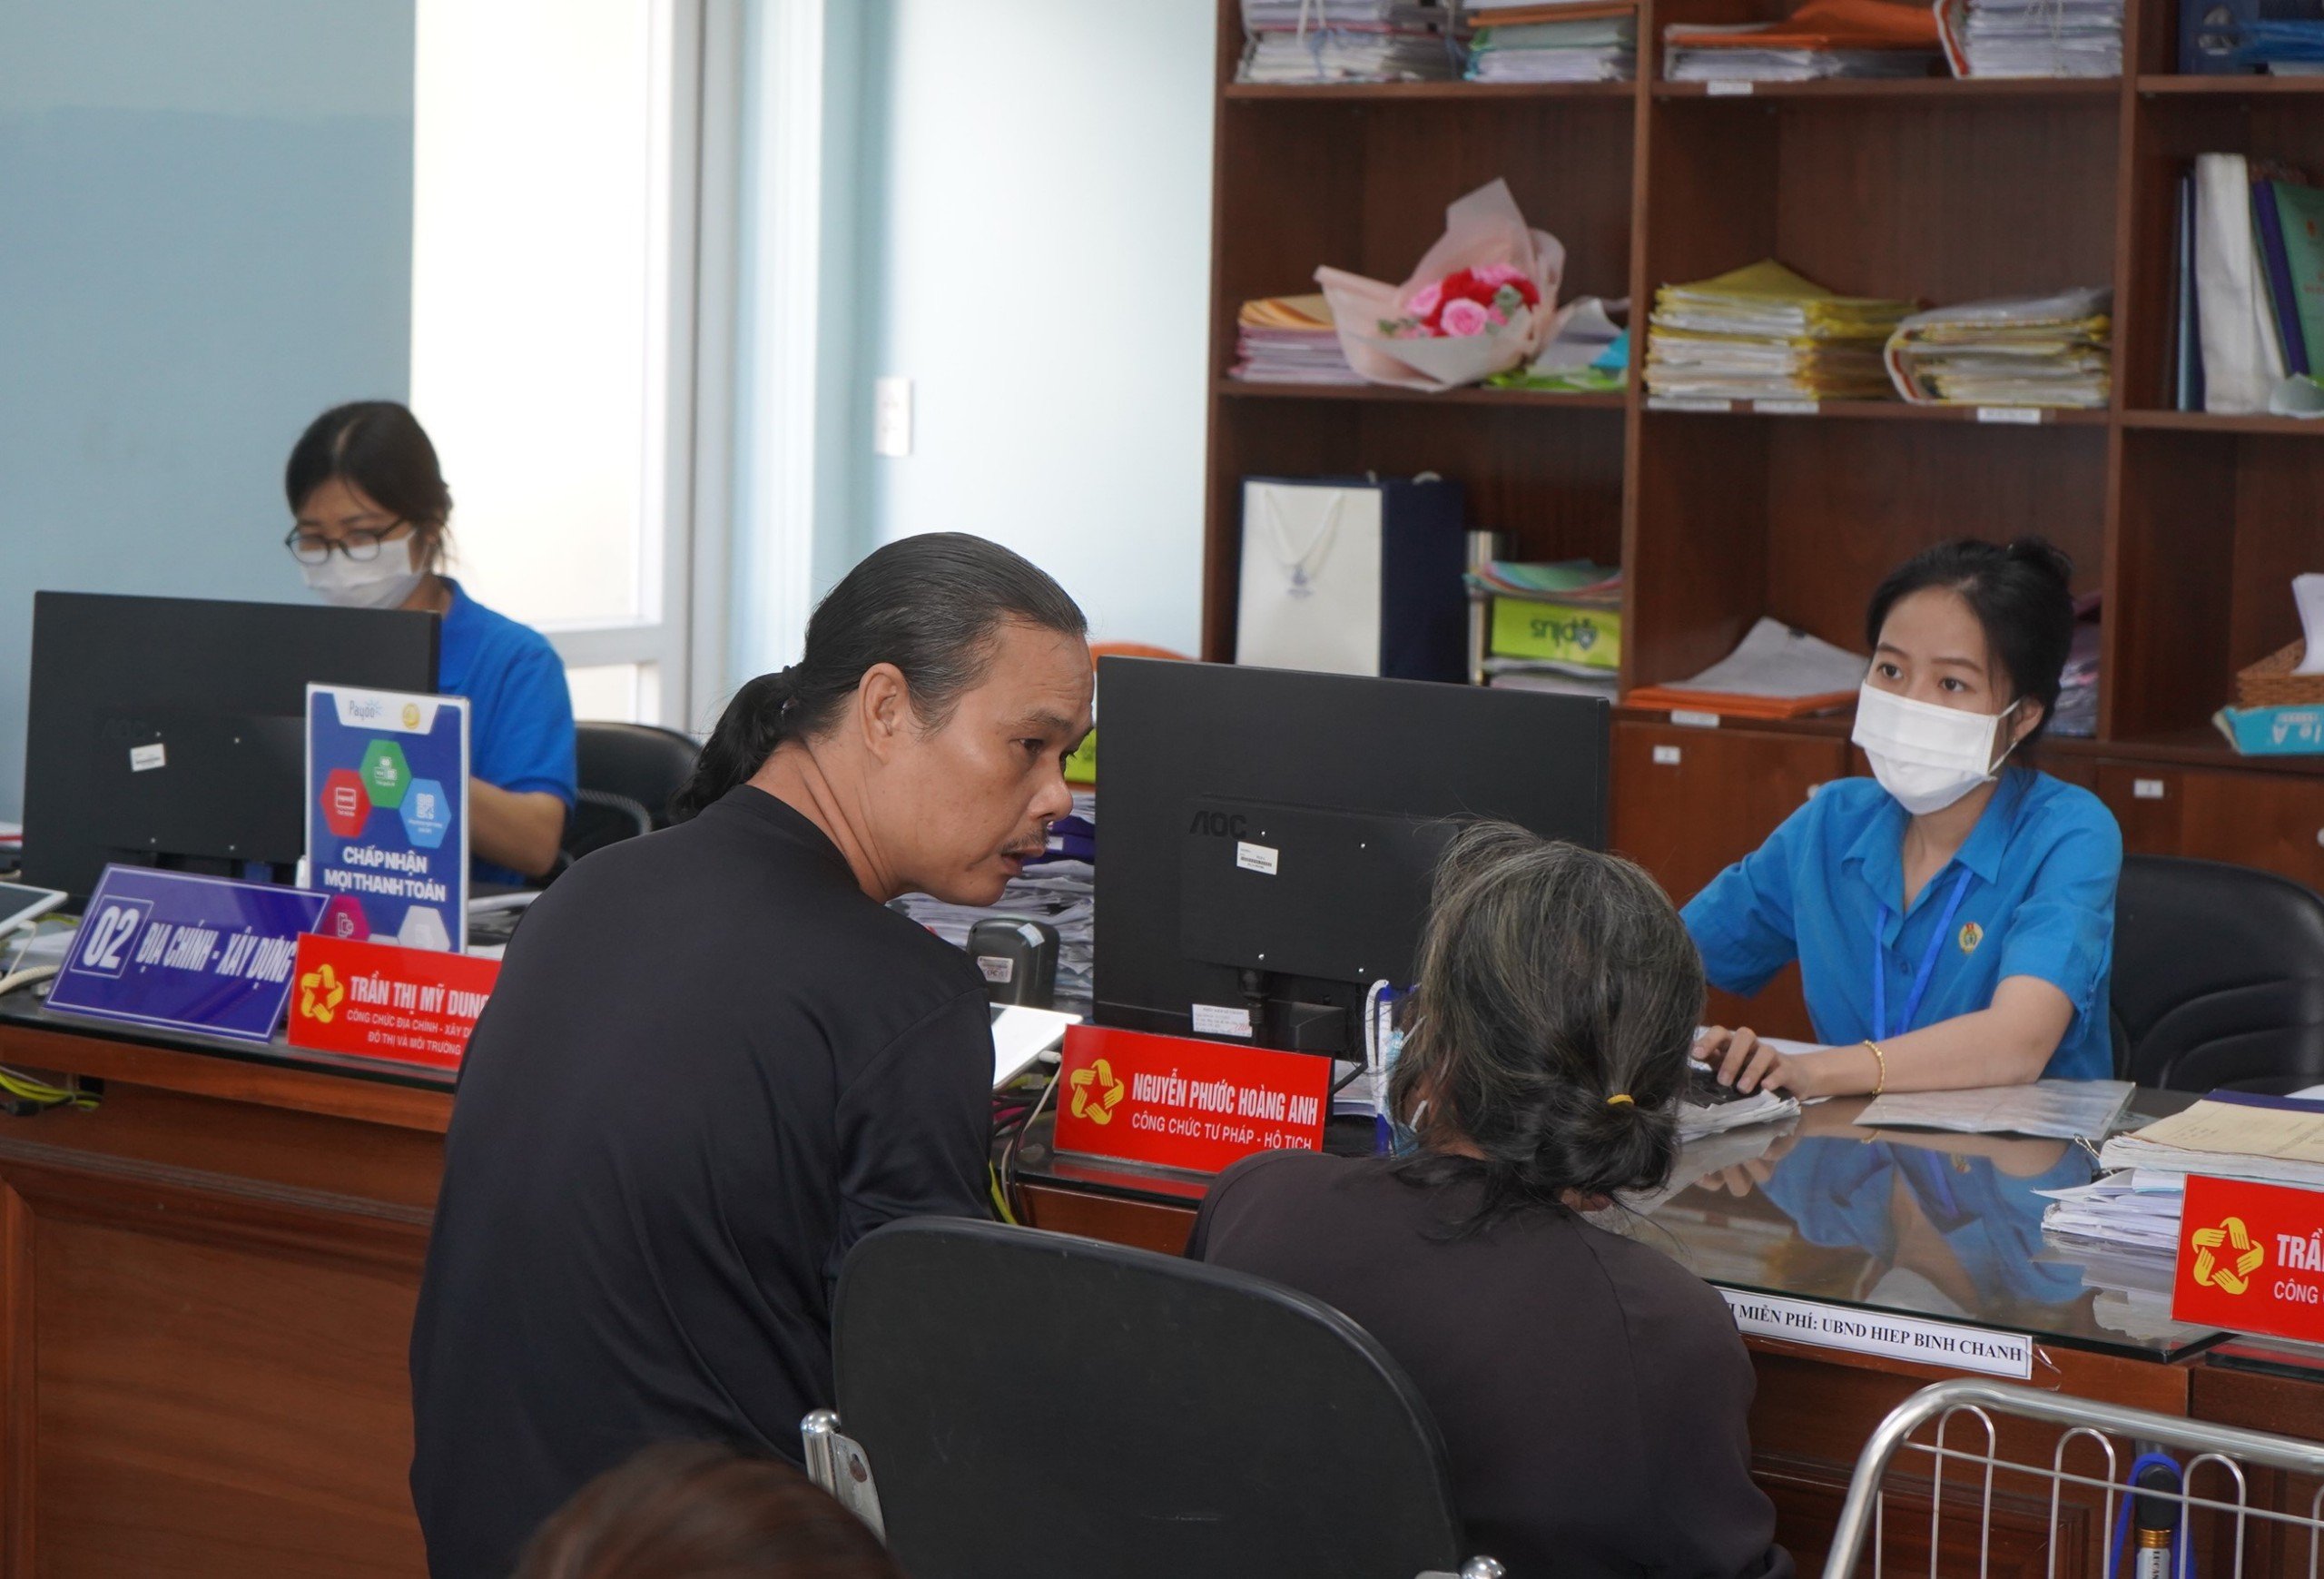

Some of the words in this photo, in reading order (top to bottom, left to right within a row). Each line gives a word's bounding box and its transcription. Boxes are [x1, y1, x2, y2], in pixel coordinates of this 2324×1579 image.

[1189, 810, 1246, 839] AOC
[342, 844, 384, 867] CHẤP
[385, 850, 428, 876] NHẬN
[324, 868, 352, 892] MỌI
[352, 873, 404, 896] THANH
[404, 878, 446, 902] TOÁN
[83, 905, 140, 969] 02
[135, 921, 172, 973] ĐỊA
[162, 919, 219, 972] CHÍNH
[215, 925, 259, 977] XÂY
[350, 971, 390, 1005] TRẦN
[393, 982, 418, 1015] THỊ
[419, 983, 445, 1013] MỸ
[347, 1008, 370, 1023] CÔNG
[372, 1012, 395, 1027] CHỨC
[1132, 1068, 1187, 1107] NGUYỄN
[1189, 1079, 1236, 1115] PHƯỚC
[1237, 1084, 1285, 1121] HOÀNG
[1287, 1094, 1319, 1126] ANH
[1132, 1110, 1165, 1131] CÔNG
[1168, 1117, 1201, 1138] CHỨC
[1205, 1123, 1221, 1140] TƯ
[1222, 1124, 1254, 1145] PHÁP
[2277, 1228, 2324, 1272] TRẦ
[2273, 1278, 2319, 1304] CÔNG
[1739, 1304, 1781, 1324] MIỄN
[1786, 1312, 1817, 1330] PHÍ:
[1822, 1318, 1866, 1337] UBND
[1870, 1326, 1910, 1344] HIEP
[1914, 1333, 1955, 1352] BINH
[1960, 1340, 2022, 1361] CHANH
